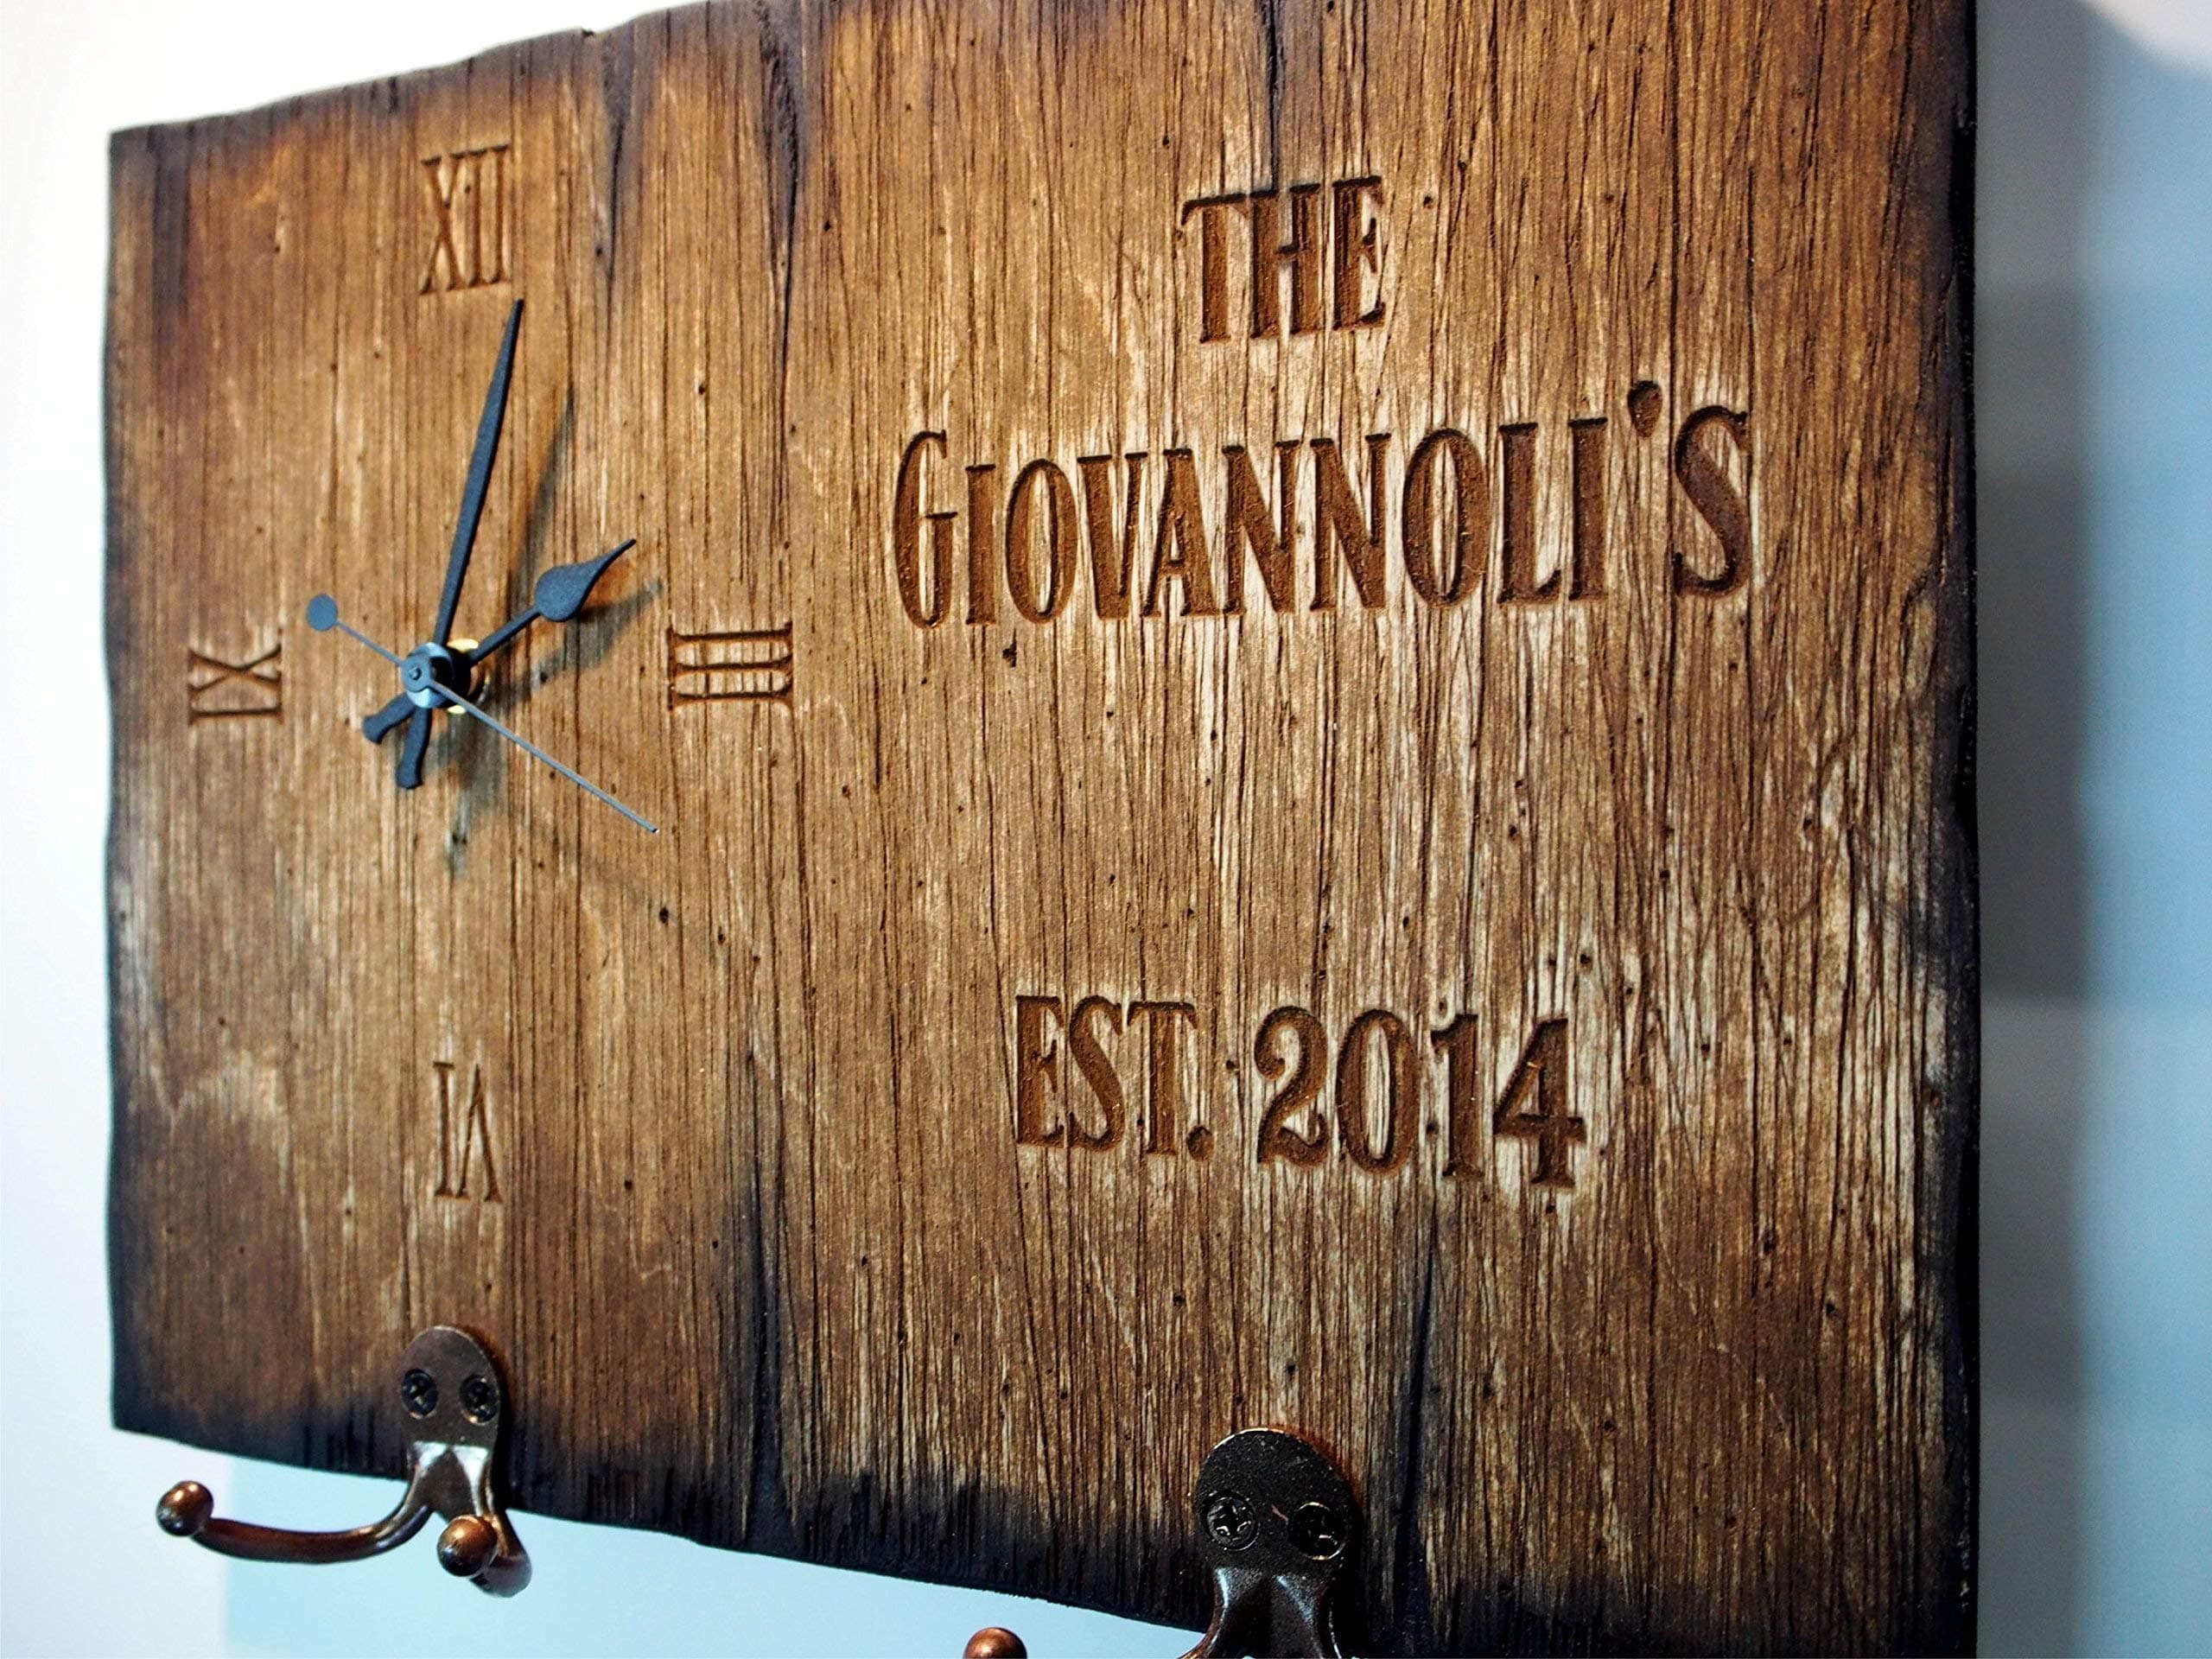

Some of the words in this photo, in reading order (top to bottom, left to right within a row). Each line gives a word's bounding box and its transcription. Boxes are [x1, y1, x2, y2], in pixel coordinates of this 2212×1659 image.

[418, 143, 511, 296] XII
[1181, 175, 1385, 344] THE
[893, 380, 1752, 630] GIOVANNOLI'S
[668, 620, 793, 711] III
[1015, 995, 1212, 1160] EST.
[1254, 1005, 1586, 1189] 2014
